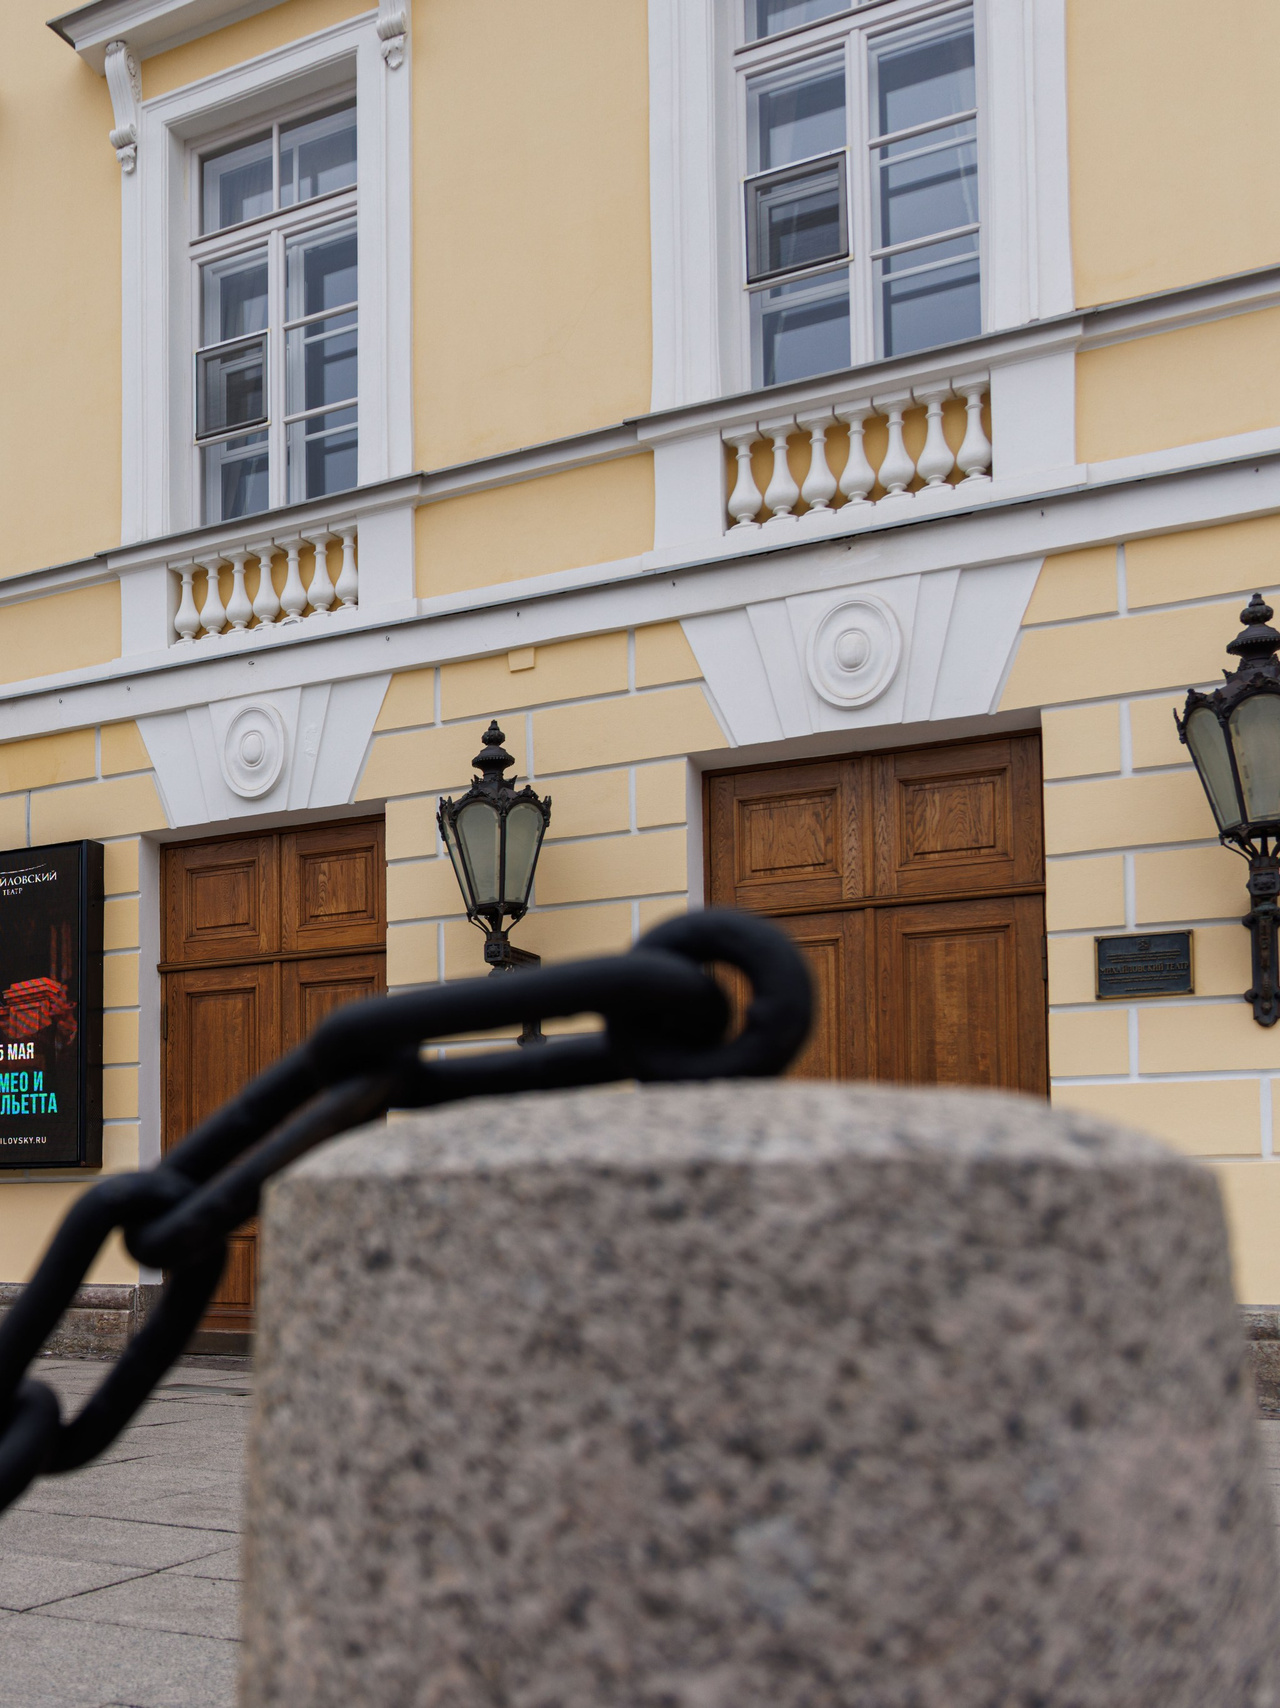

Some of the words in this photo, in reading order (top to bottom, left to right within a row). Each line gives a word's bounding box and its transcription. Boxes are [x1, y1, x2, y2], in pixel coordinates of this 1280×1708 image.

[3, 888, 22, 896] ТЕАТР
[1166, 962, 1189, 971] ТЕАТР
[7, 1042, 35, 1060] МАЯ
[33, 1071, 43, 1091] И
